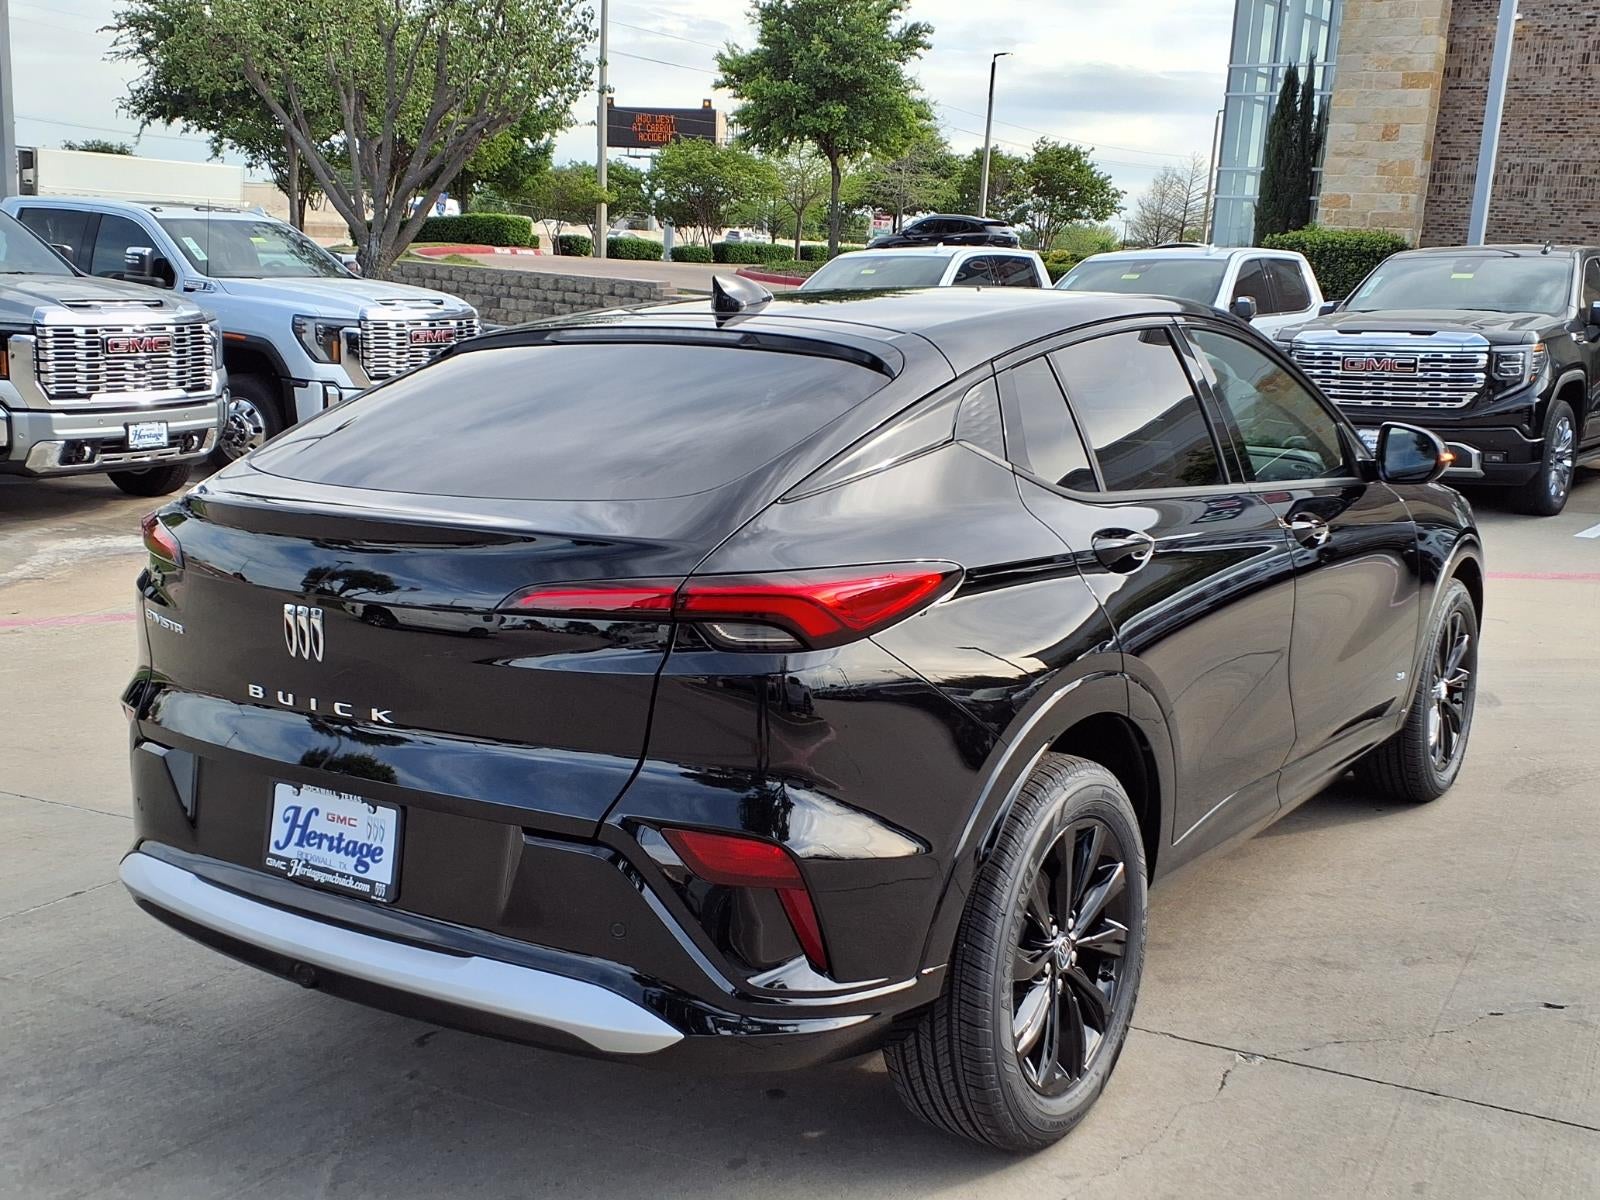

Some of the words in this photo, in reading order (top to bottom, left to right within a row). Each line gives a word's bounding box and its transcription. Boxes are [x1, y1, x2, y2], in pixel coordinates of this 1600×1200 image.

[655, 114, 674, 124] WEST
[632, 123, 641, 131] AT
[646, 124, 677, 133] CARROLL
[638, 132, 671, 141] ACCIDENT
[411, 329, 455, 343] GMC
[107, 336, 172, 353] GMC
[1344, 357, 1415, 371] GMC
[248, 683, 394, 724] BUICK
[326, 811, 358, 828] GMC
[274, 805, 384, 874] Heritage
[265, 857, 287, 870] GMC
